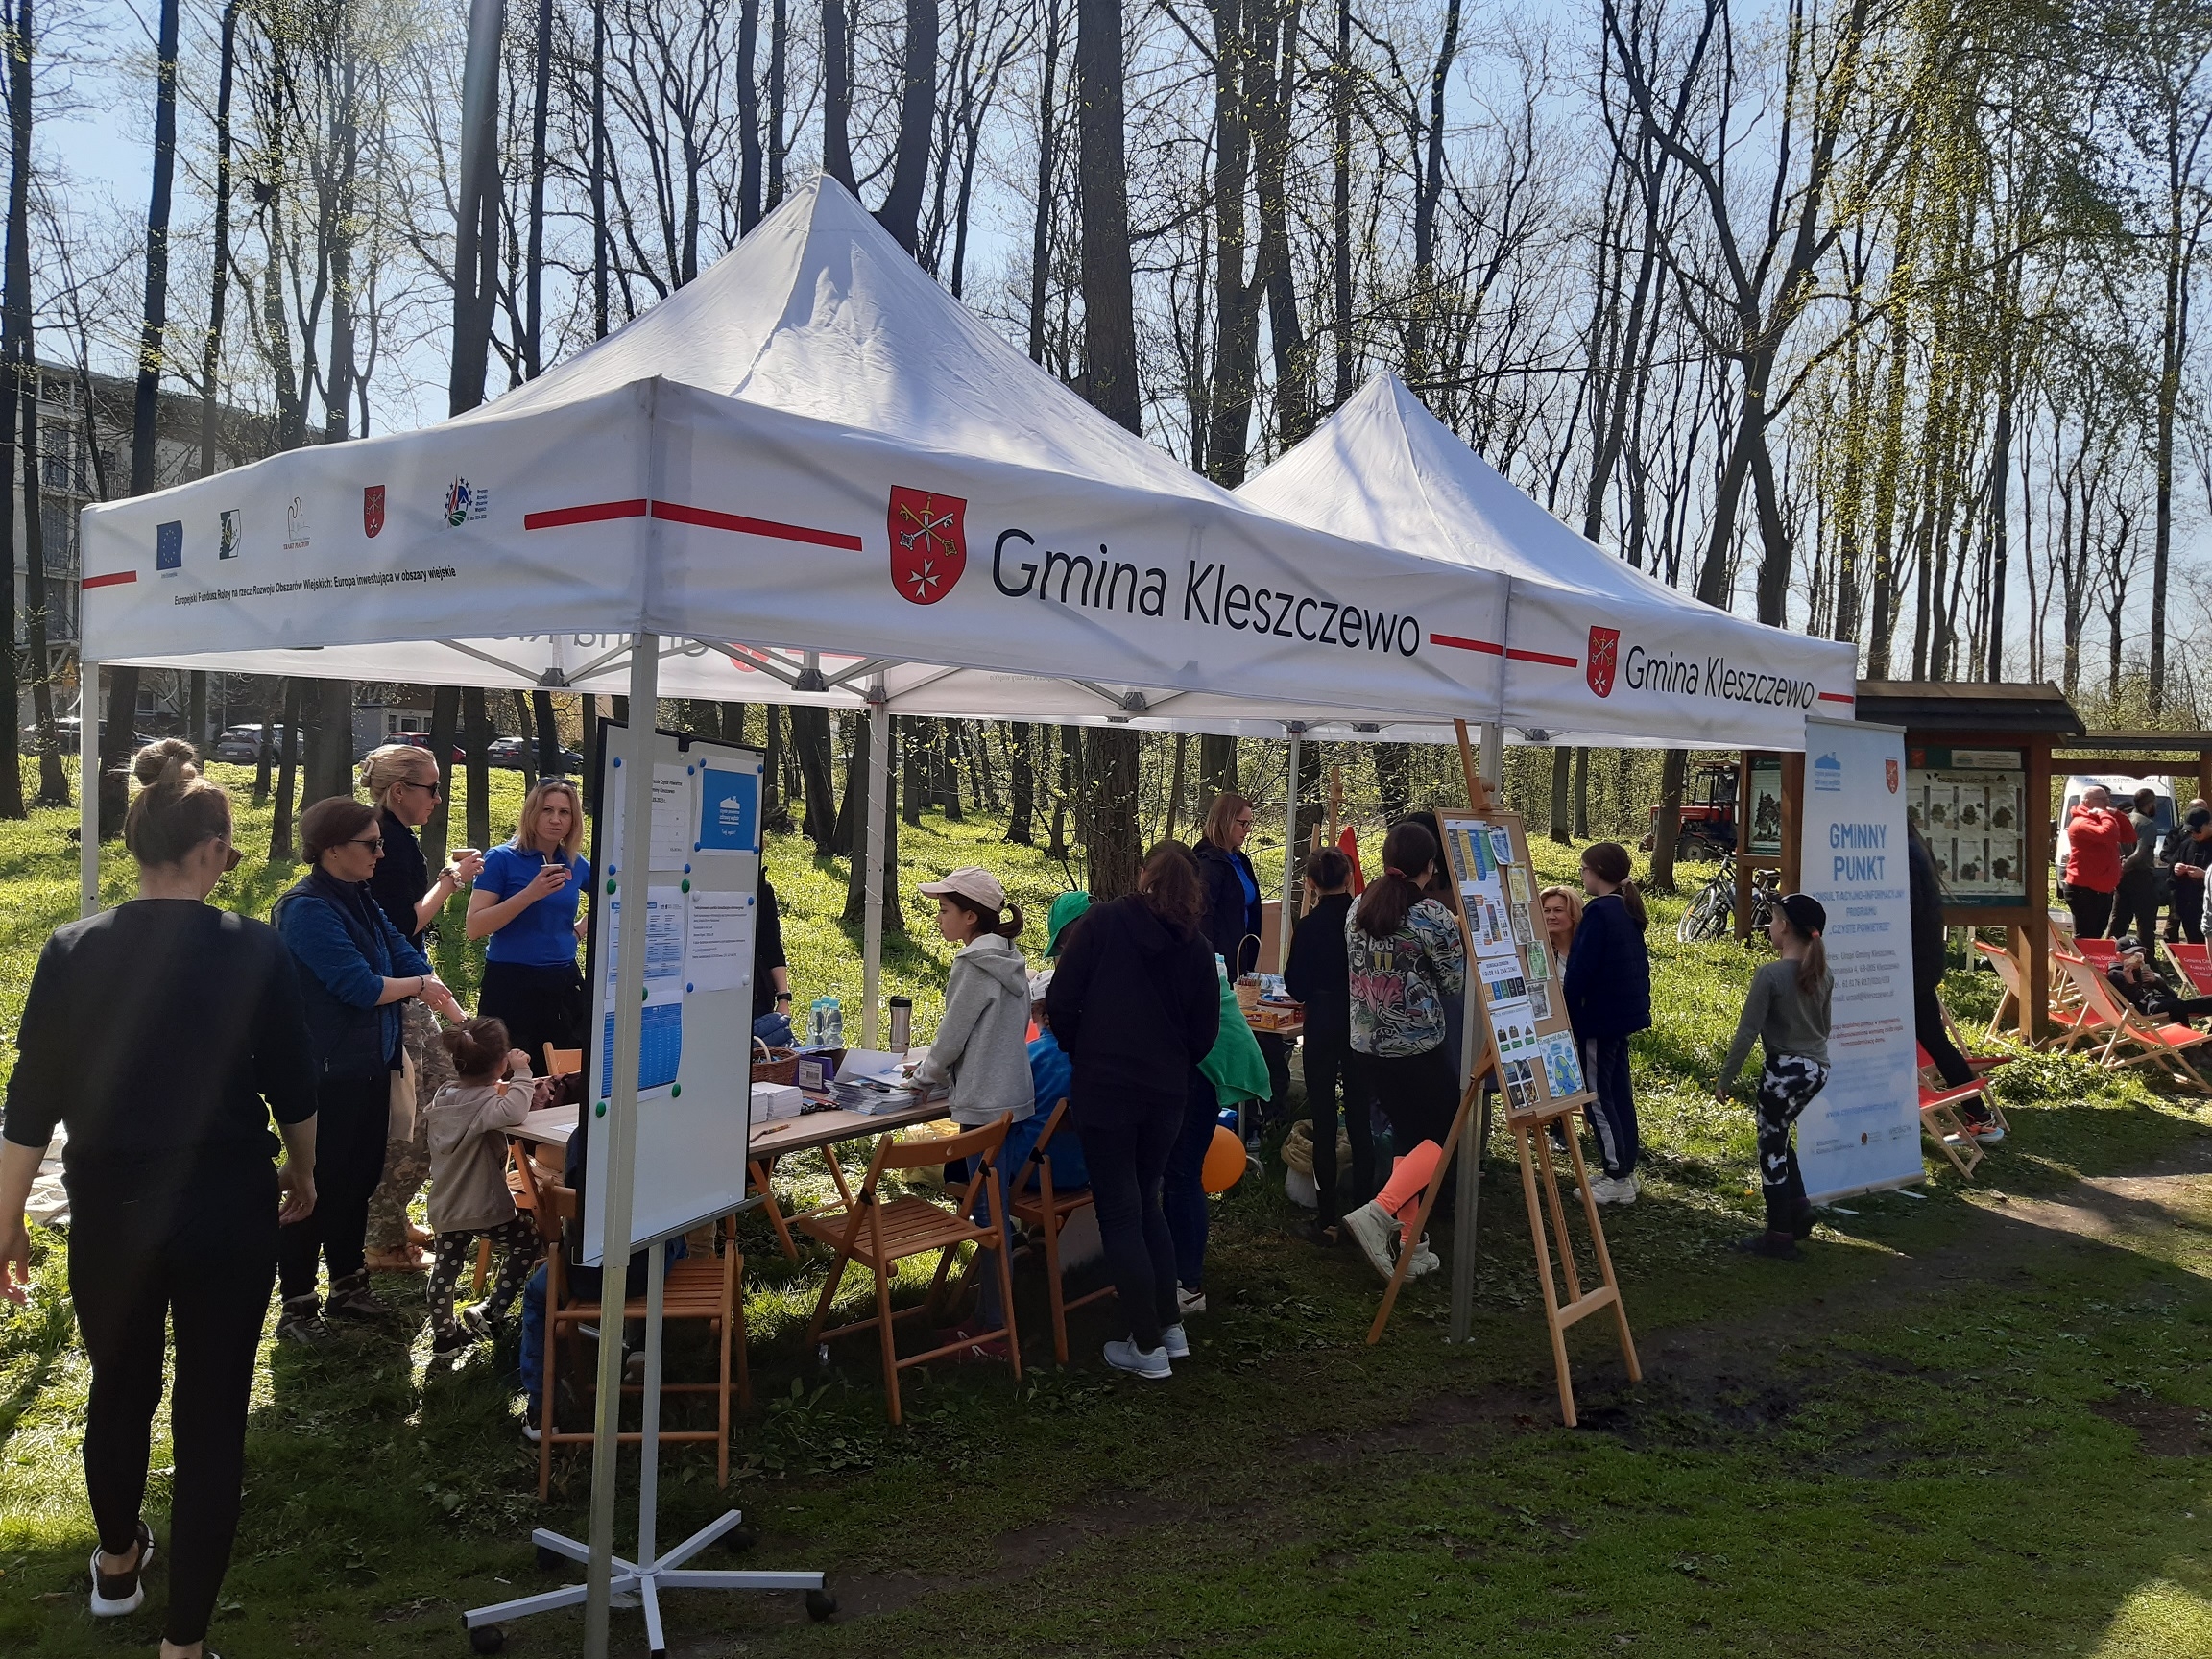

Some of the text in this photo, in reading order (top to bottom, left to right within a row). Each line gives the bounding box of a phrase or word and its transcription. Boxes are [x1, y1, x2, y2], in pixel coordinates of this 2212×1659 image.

[174, 565, 457, 607] Europejski Fundusz Rolny na rzecz Rozwoju Obszarów Wiejskich: Europa inwestująca w obszary wiejskie
[991, 528, 1422, 658] Gmina Kleszczewo
[1625, 645, 1815, 709] Gmina Kleszczewo
[1829, 823, 1887, 849] GMINNY
[1833, 855, 1886, 882] PUNKT
